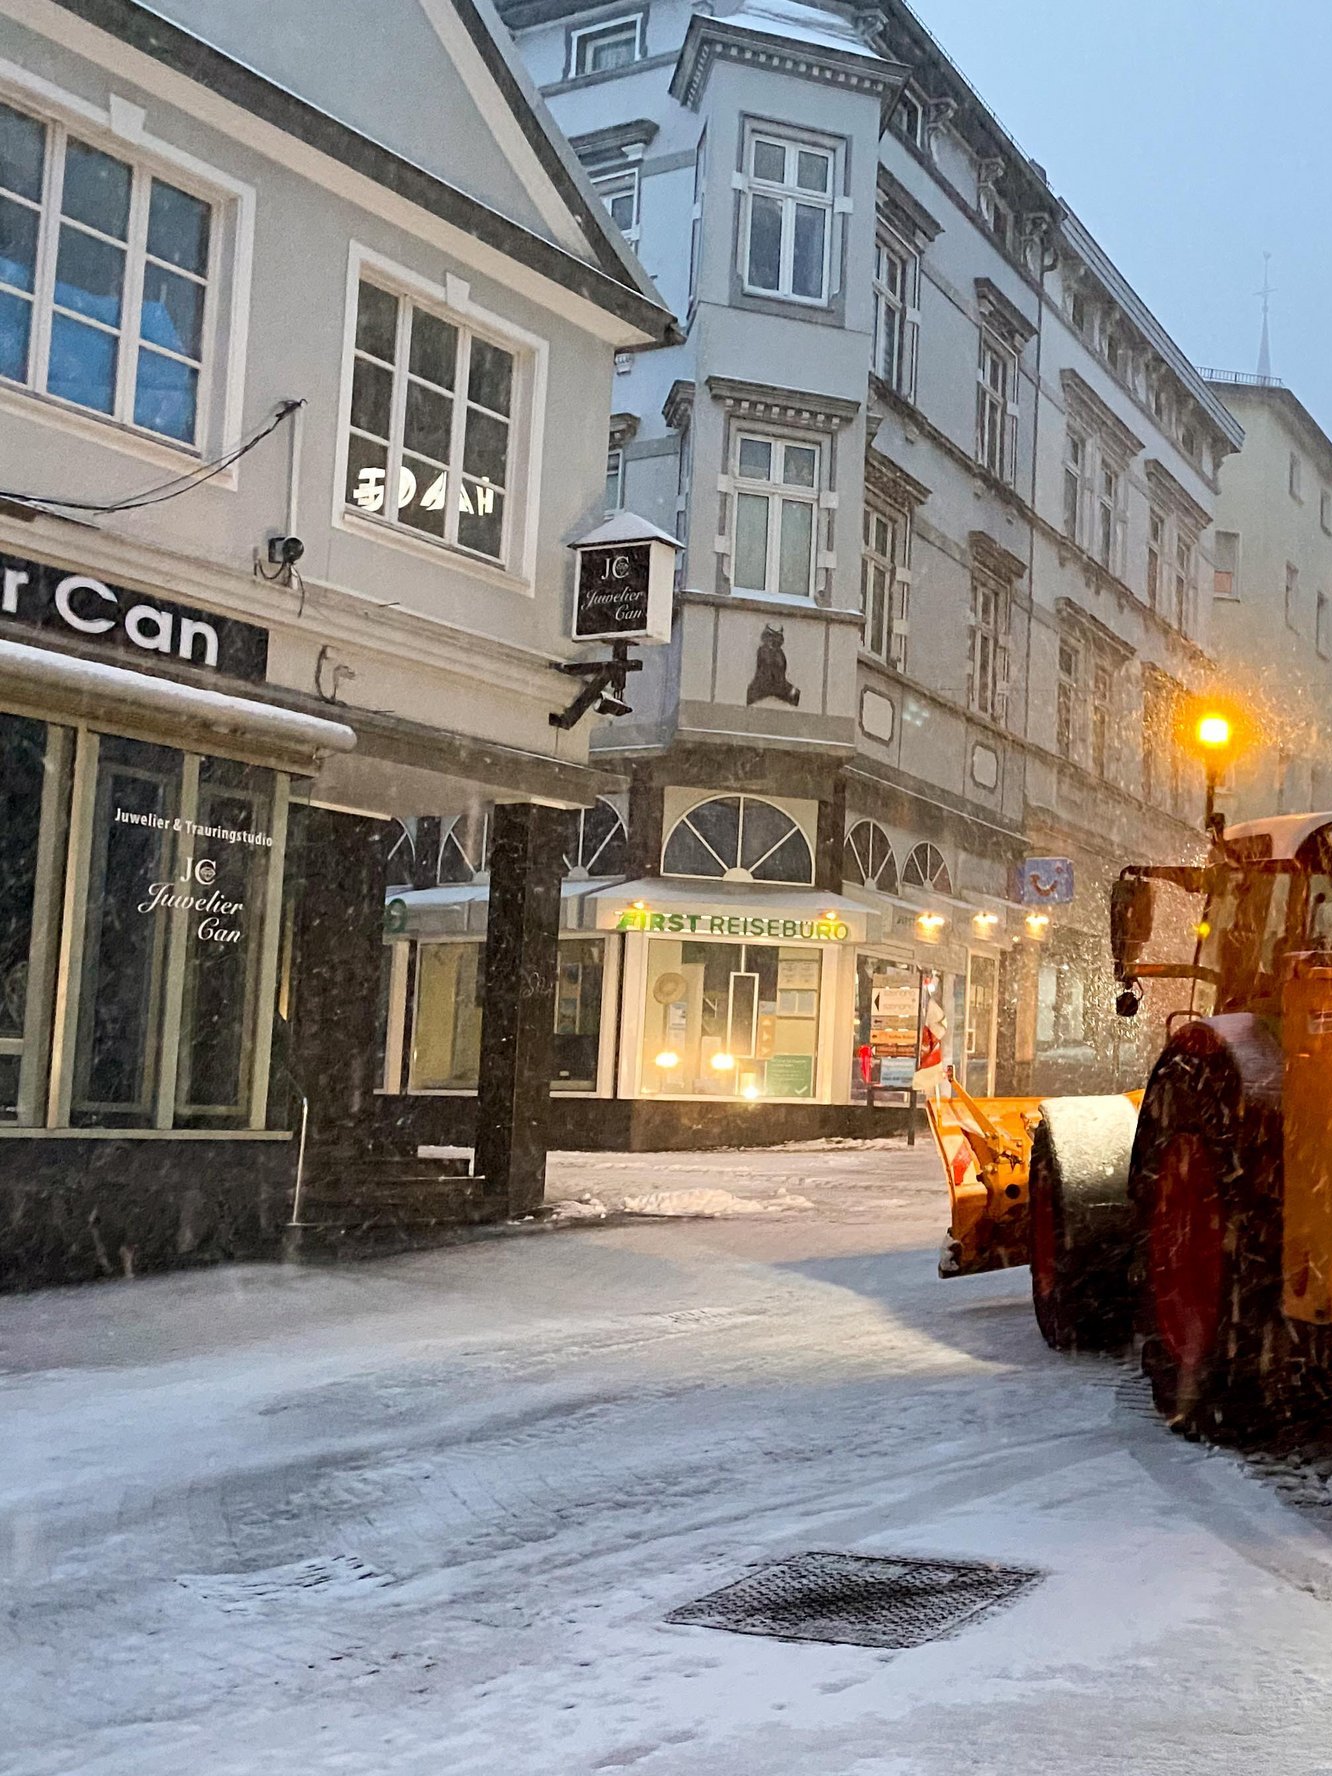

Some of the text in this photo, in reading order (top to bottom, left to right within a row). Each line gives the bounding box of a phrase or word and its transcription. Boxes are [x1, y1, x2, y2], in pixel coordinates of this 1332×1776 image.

[581, 586, 643, 611] Juwelier
[55, 575, 219, 667] Can
[615, 604, 643, 621] Can
[115, 808, 273, 847] Juwelier & Trauringstudio
[137, 882, 243, 915] Juwelier
[198, 917, 241, 943] Can
[708, 917, 849, 941] REISEBÜRO
